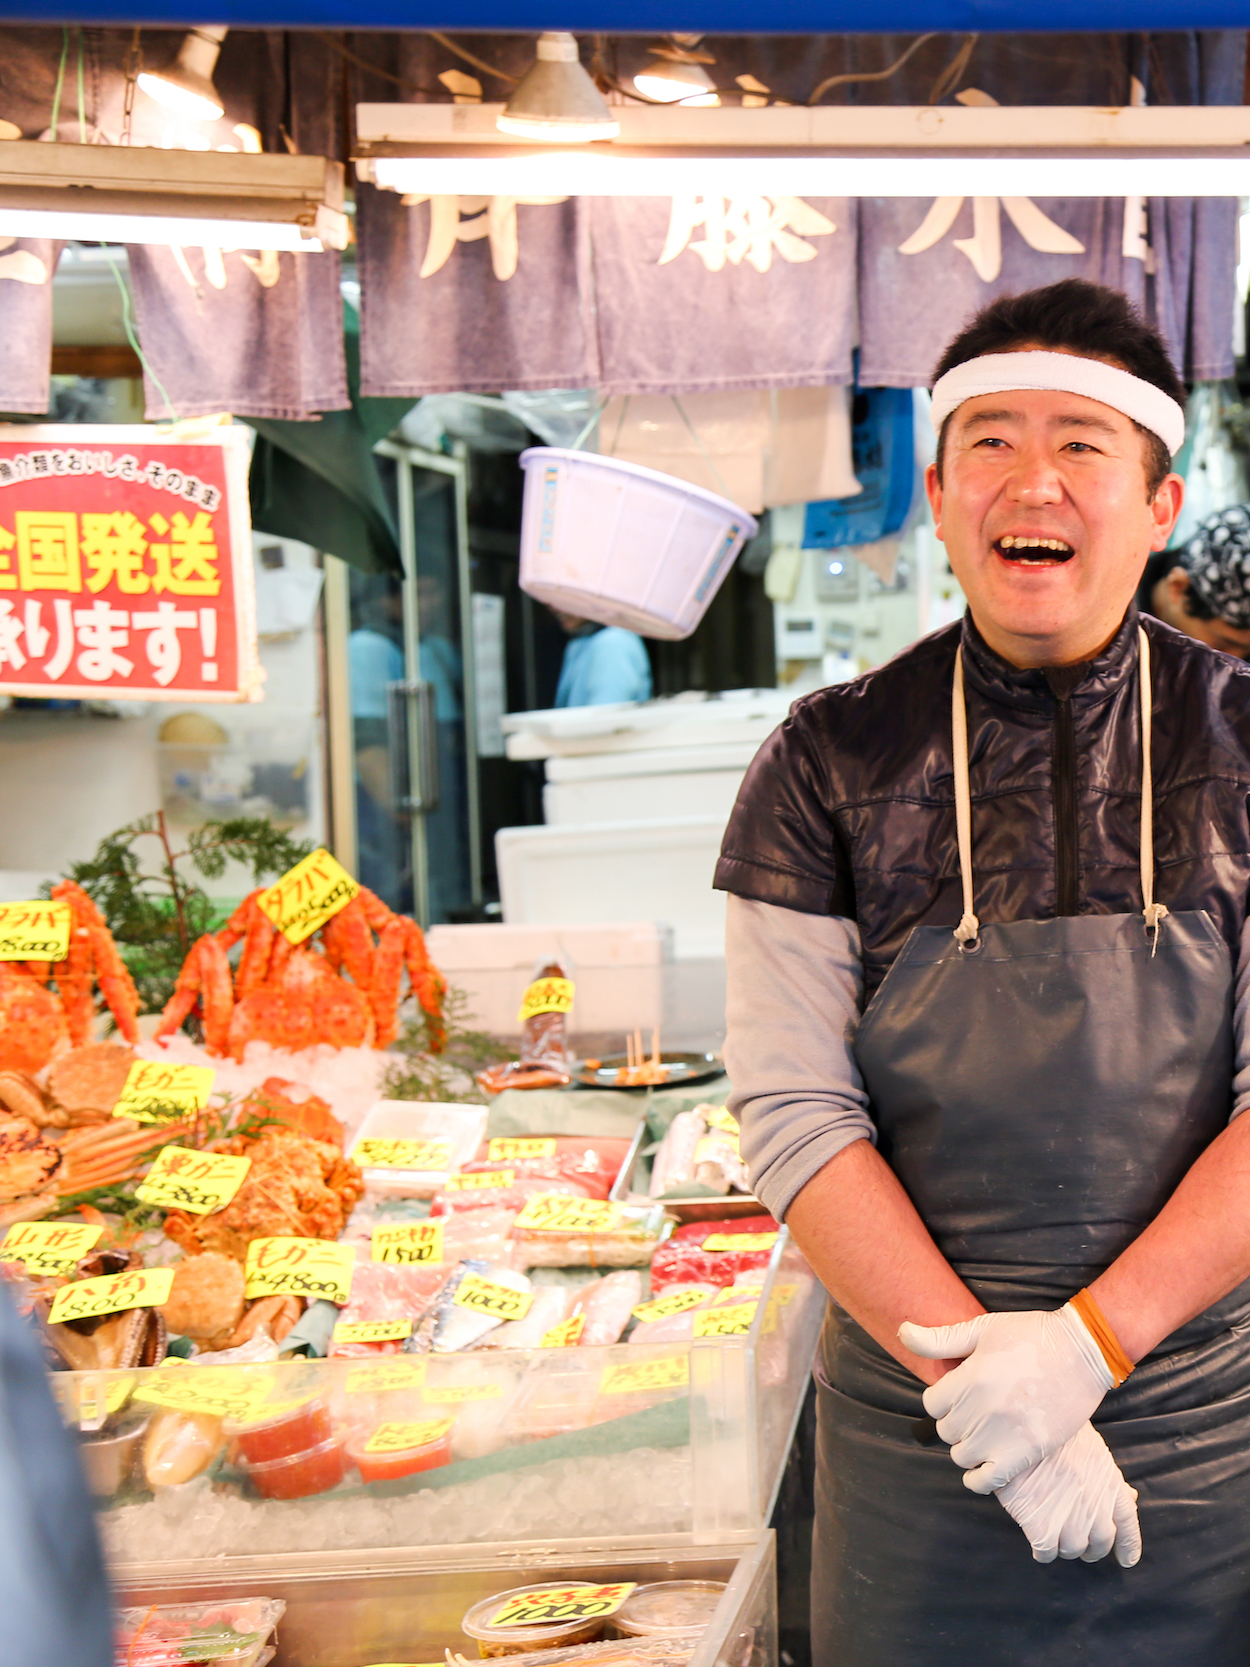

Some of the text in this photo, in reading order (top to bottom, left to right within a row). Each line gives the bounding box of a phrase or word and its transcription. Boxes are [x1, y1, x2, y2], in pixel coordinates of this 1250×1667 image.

[0, 511, 221, 595] 国発送
[382, 1245, 433, 1262] 1500
[60, 1273, 146, 1305] 八角
[61, 1293, 135, 1317] 800
[463, 1291, 519, 1312] 1000
[493, 1602, 612, 1625] 1000
